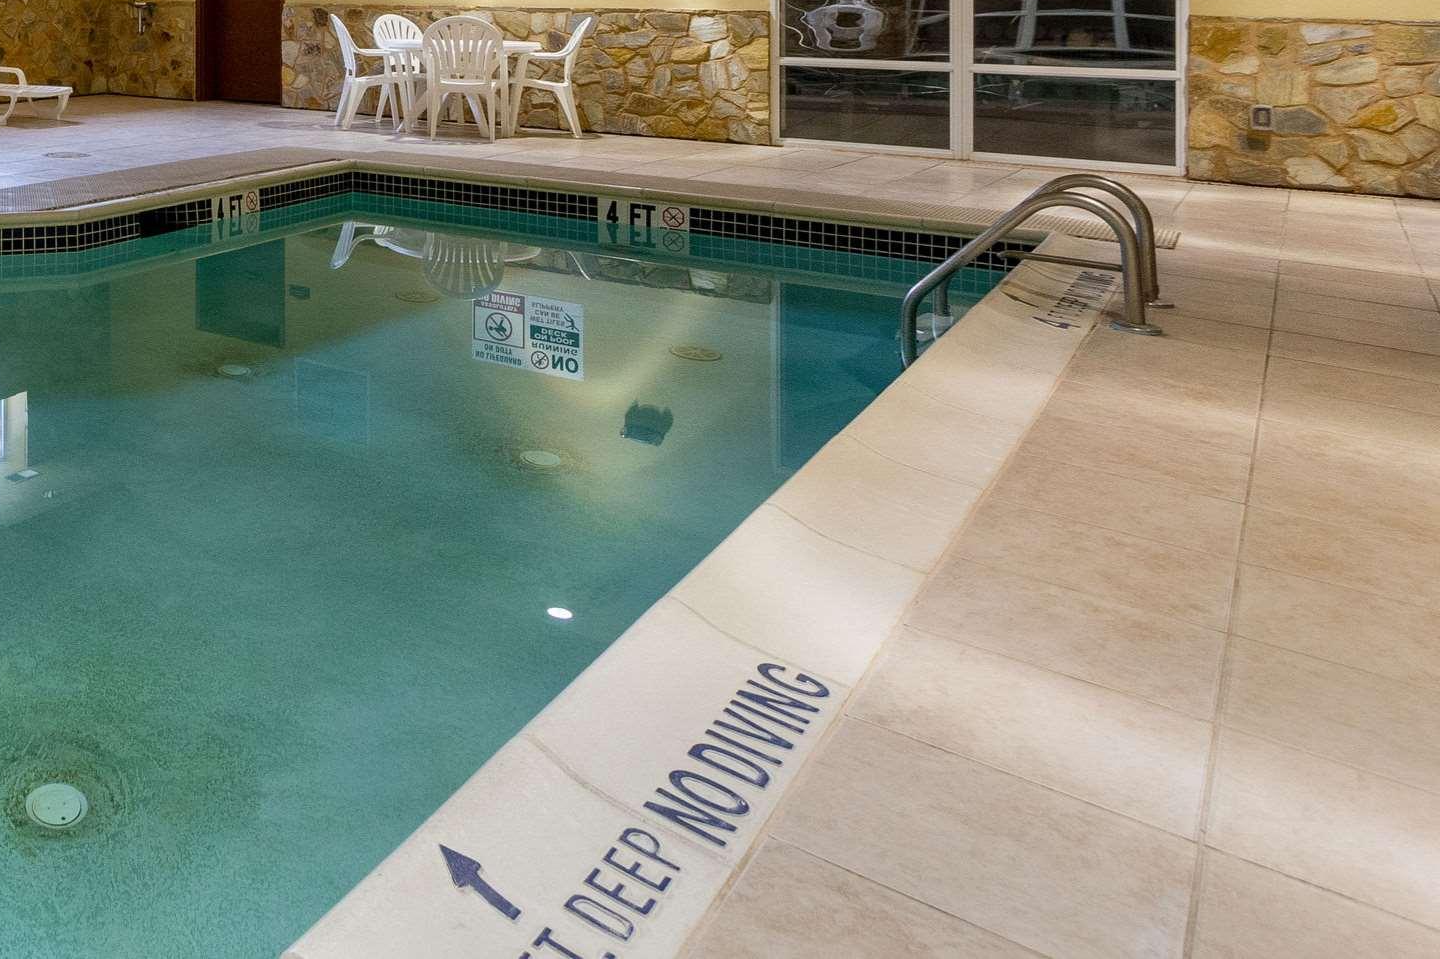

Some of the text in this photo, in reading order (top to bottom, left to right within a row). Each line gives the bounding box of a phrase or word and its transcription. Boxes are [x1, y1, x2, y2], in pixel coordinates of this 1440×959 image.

[229, 194, 243, 218] FT
[606, 200, 657, 228] 4 FT
[563, 827, 681, 941] DEEP
